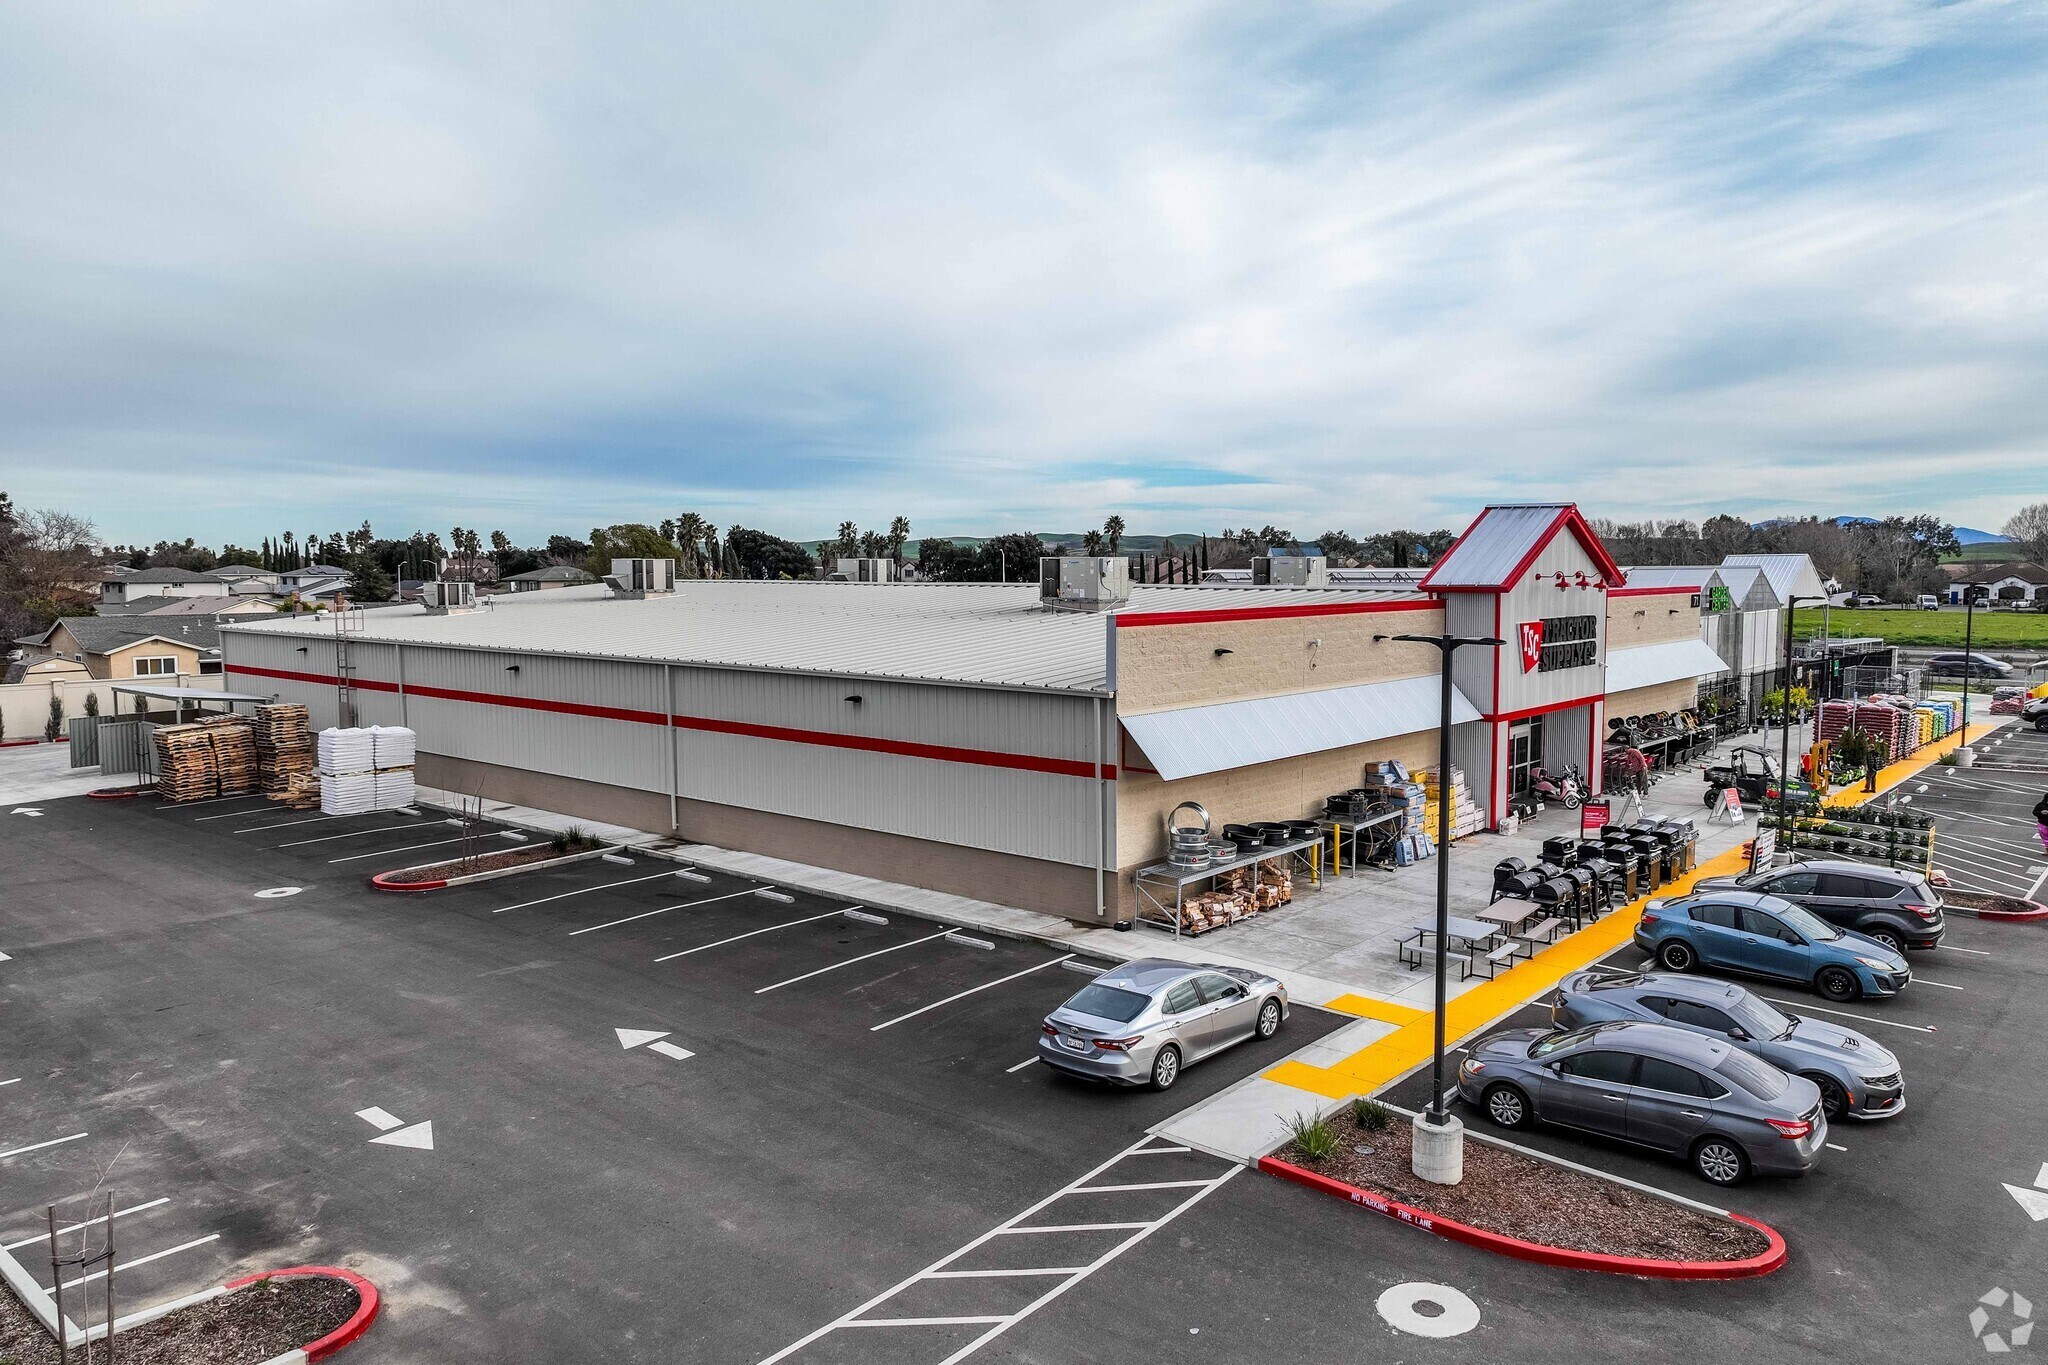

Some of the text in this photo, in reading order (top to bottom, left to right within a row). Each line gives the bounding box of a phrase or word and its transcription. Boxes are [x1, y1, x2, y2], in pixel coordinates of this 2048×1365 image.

[1523, 625, 1539, 661] TSC
[1540, 615, 1597, 643] TRACTOR
[1540, 643, 1584, 672] SUPPLY
[1351, 1192, 1433, 1230] NO PARKING FIRE LANE
